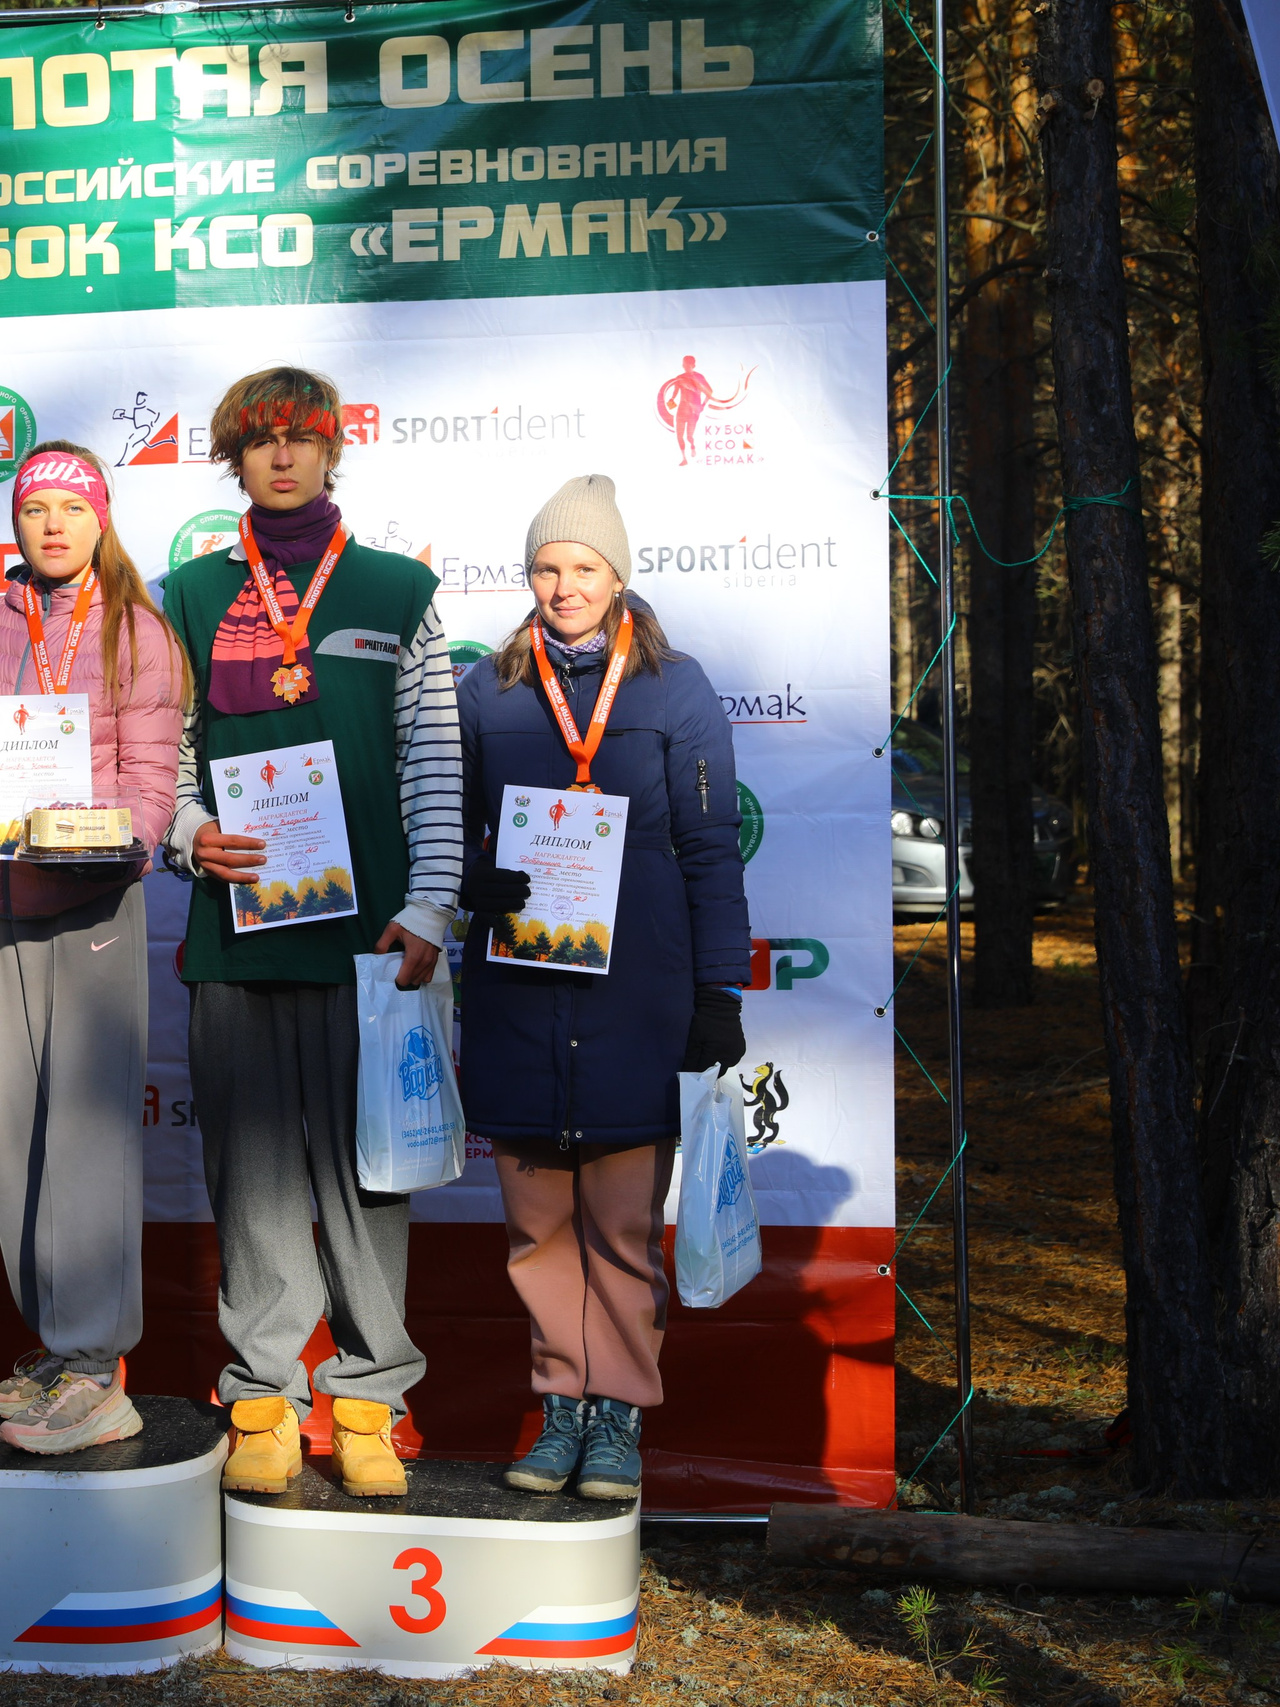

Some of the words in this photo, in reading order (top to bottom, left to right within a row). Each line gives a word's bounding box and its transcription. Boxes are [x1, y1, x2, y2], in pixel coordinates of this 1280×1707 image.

[379, 19, 754, 109] ОСЕНЬ
[306, 136, 727, 191] СОРЕВНОВАНИЯ
[153, 212, 313, 271] КСО
[349, 196, 728, 264] «ЕРМАК»
[392, 405, 586, 444] SPORTident
[705, 424, 753, 435] КУБОК
[705, 439, 736, 450] КСО
[200, 514, 240, 525] СПОРТИВН
[638, 534, 838, 574] SPORTident
[258, 562, 270, 587] ОСЕНЬ
[307, 575, 326, 610] ЗОЛОТАЯ
[324, 553, 338, 578] ОСЕНЬ
[442, 557, 526, 595] Ерма
[723, 572, 797, 588] siberia
[266, 587, 284, 624] ЗОЛОТАЯ
[38, 640, 49, 665] ОСЕНЬ
[60, 649, 74, 686] ЗОЛОТАЯ
[71, 621, 83, 647] ОСЕНЬ
[293, 668, 303, 680] 3
[550, 676, 564, 704] ОСЕНЬ
[598, 685, 615, 724] ЗОЛОТАЯ
[612, 655, 626, 684] ОСЕНЬ
[561, 706, 579, 742] ЗОЛОТАЯ
[0, 740, 59, 752] ДИПЛОМ
[251, 791, 310, 812] ДИПЛОМ
[258, 808, 308, 822] НАГРАЖДАЕТСЯ
[286, 825, 309, 833] место
[529, 834, 593, 851] ДИПЛОМ
[534, 851, 586, 862] НАГРАЖДАЕТСЯ
[559, 870, 582, 878] место
[465, 1148, 494, 1159] ЕРМ
[388, 1547, 447, 1636] 3
